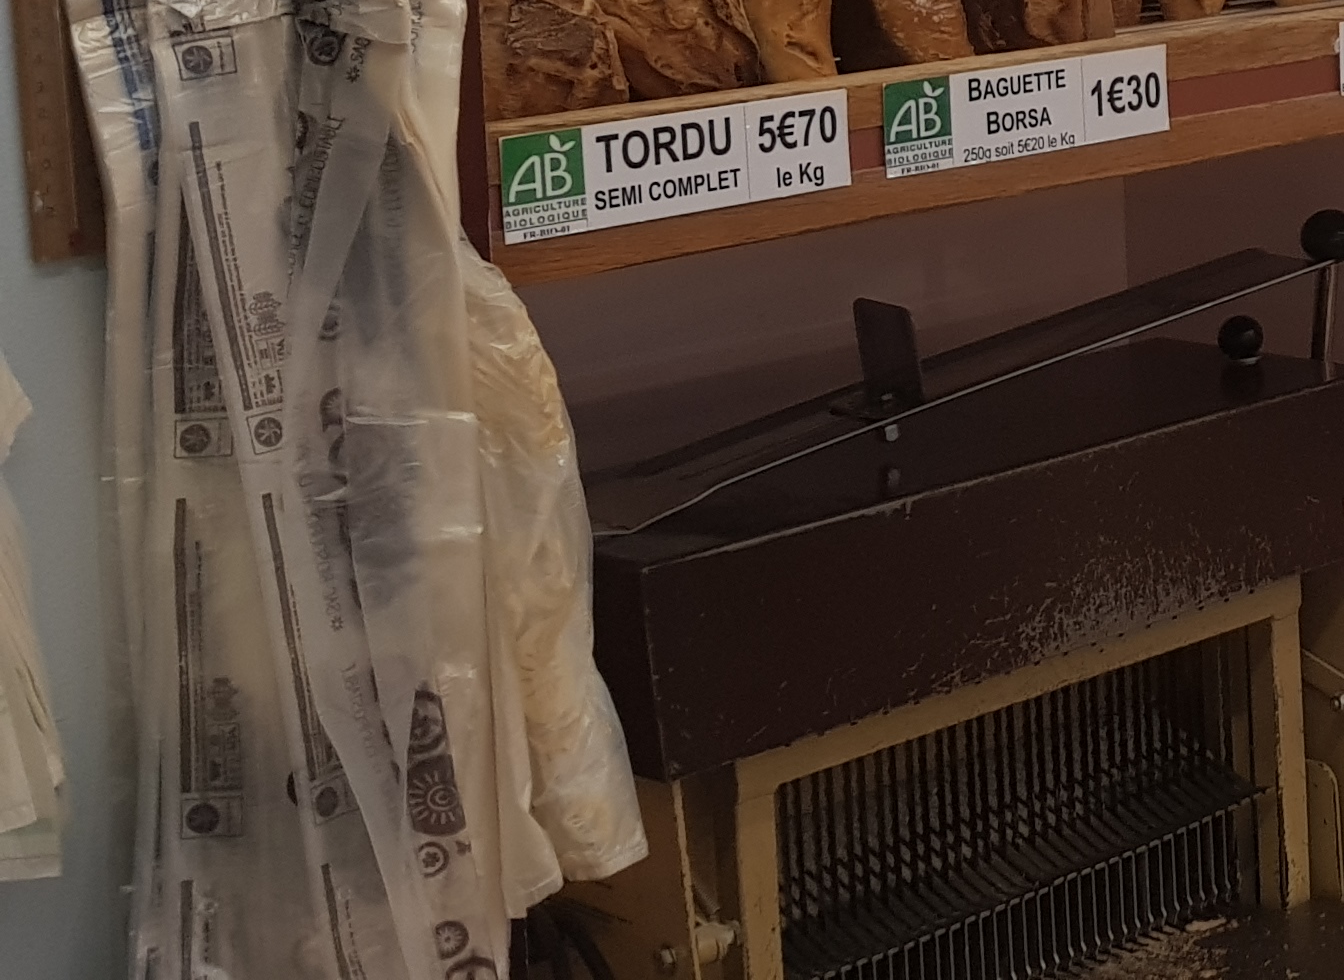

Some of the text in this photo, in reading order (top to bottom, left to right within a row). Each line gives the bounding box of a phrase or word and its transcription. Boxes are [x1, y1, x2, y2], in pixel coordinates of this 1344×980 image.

[1091, 72, 1160, 116] 1€30
[758, 106, 836, 153] 5€70
[890, 98, 941, 142] AB
[596, 118, 731, 173] TORDU
[964, 132, 1075, 163] 250g soit 5€20 le Kg
[509, 153, 573, 203] AB
[594, 168, 740, 211] SEMI COMPLET
[776, 162, 824, 188] le Kg
[505, 198, 587, 218] AGRICULTURE
[505, 209, 588, 230] BIOLOGIQUE
